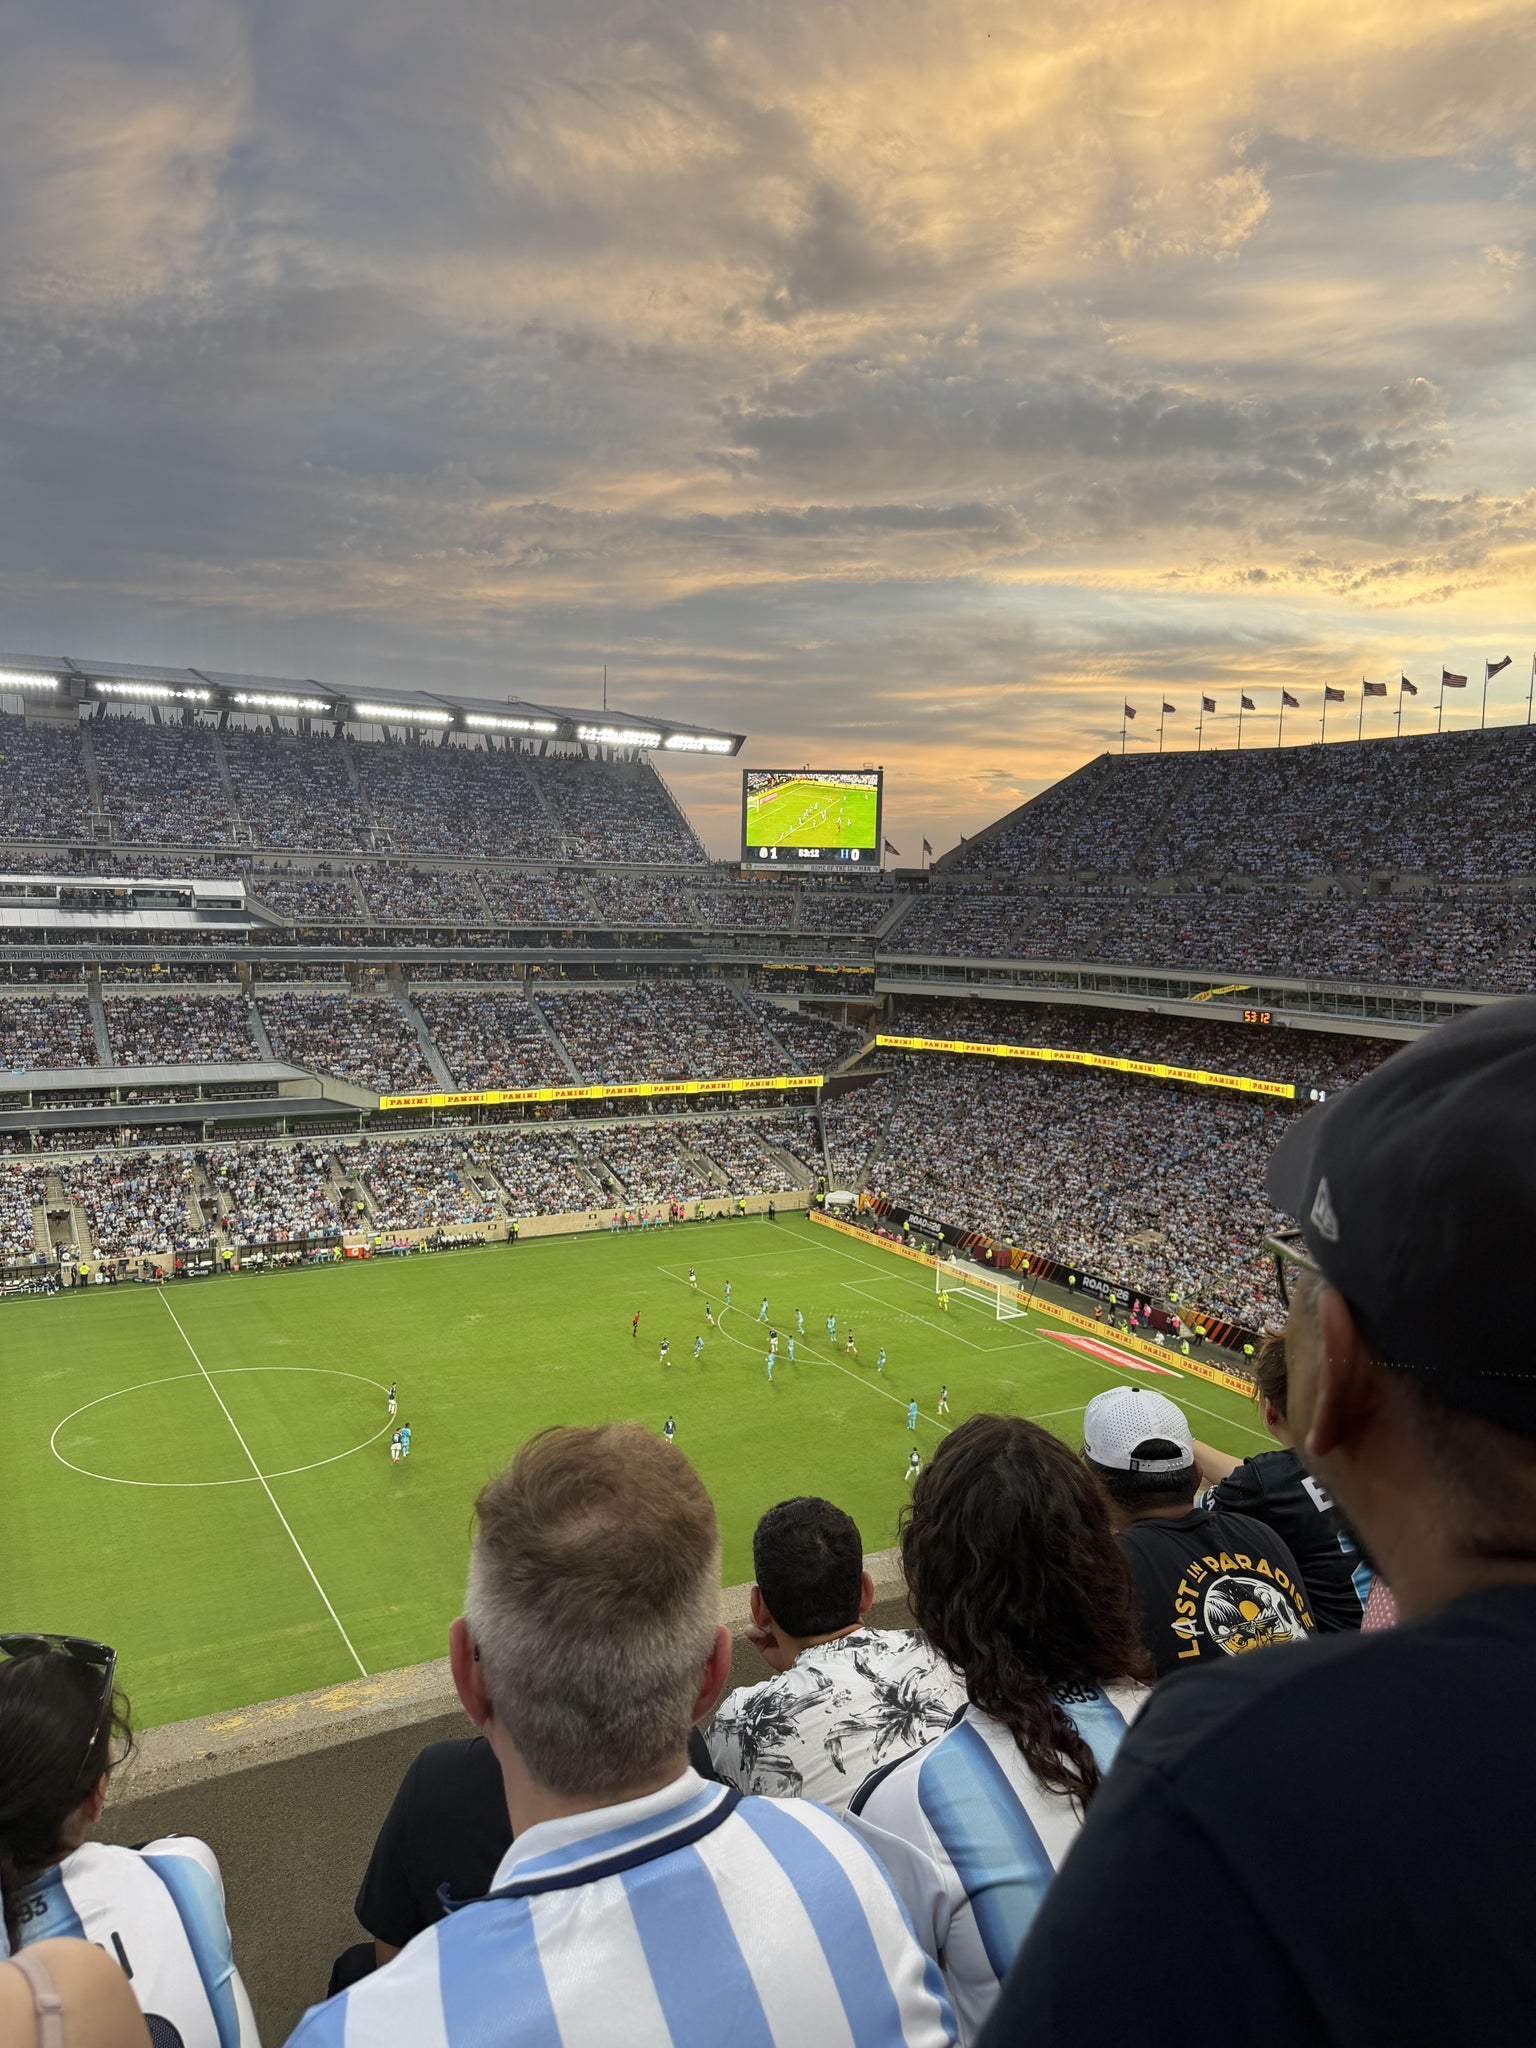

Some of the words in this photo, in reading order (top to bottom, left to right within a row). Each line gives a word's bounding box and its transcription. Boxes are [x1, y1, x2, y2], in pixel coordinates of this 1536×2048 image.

[770, 847, 778, 859] 1
[798, 848, 820, 858] 53:12
[850, 849, 860, 861] 0
[91, 952, 112, 960] TO
[924, 1041, 953, 1049] PANINI
[1008, 1048, 1040, 1056] PANINI
[1054, 1052, 1084, 1061] PANINI
[1094, 1057, 1119, 1067] PANINI
[1130, 1063, 1156, 1073] PANINI
[1168, 1069, 1196, 1079] PANINI
[1208, 1076, 1239, 1086] PANINI
[1252, 1082, 1285, 1094] PANINI
[389, 1098, 429, 1106] PANINI
[448, 1095, 484, 1103] PANINI
[502, 1092, 538, 1100] PANINI
[700, 1082, 731, 1090] PANINI
[1319, 1090, 1326, 1102] 1
[908, 1214, 928, 1227] ROAD
[1082, 1276, 1110, 1294] ROAD
[1116, 1289, 1130, 1302] 26
[878, 1239, 894, 1250] PANINI
[902, 1248, 919, 1259] PANINI
[1040, 1302, 1062, 1316] PANINI
[1071, 1316, 1096, 1330] PANINI
[1106, 1329, 1132, 1344] PANINI
[1143, 1344, 1171, 1360] PANINI
[1182, 1360, 1213, 1378] PANINI
[1186, 1560, 1203, 1578] IN
[1202, 1552, 1314, 1630] PARADISE
